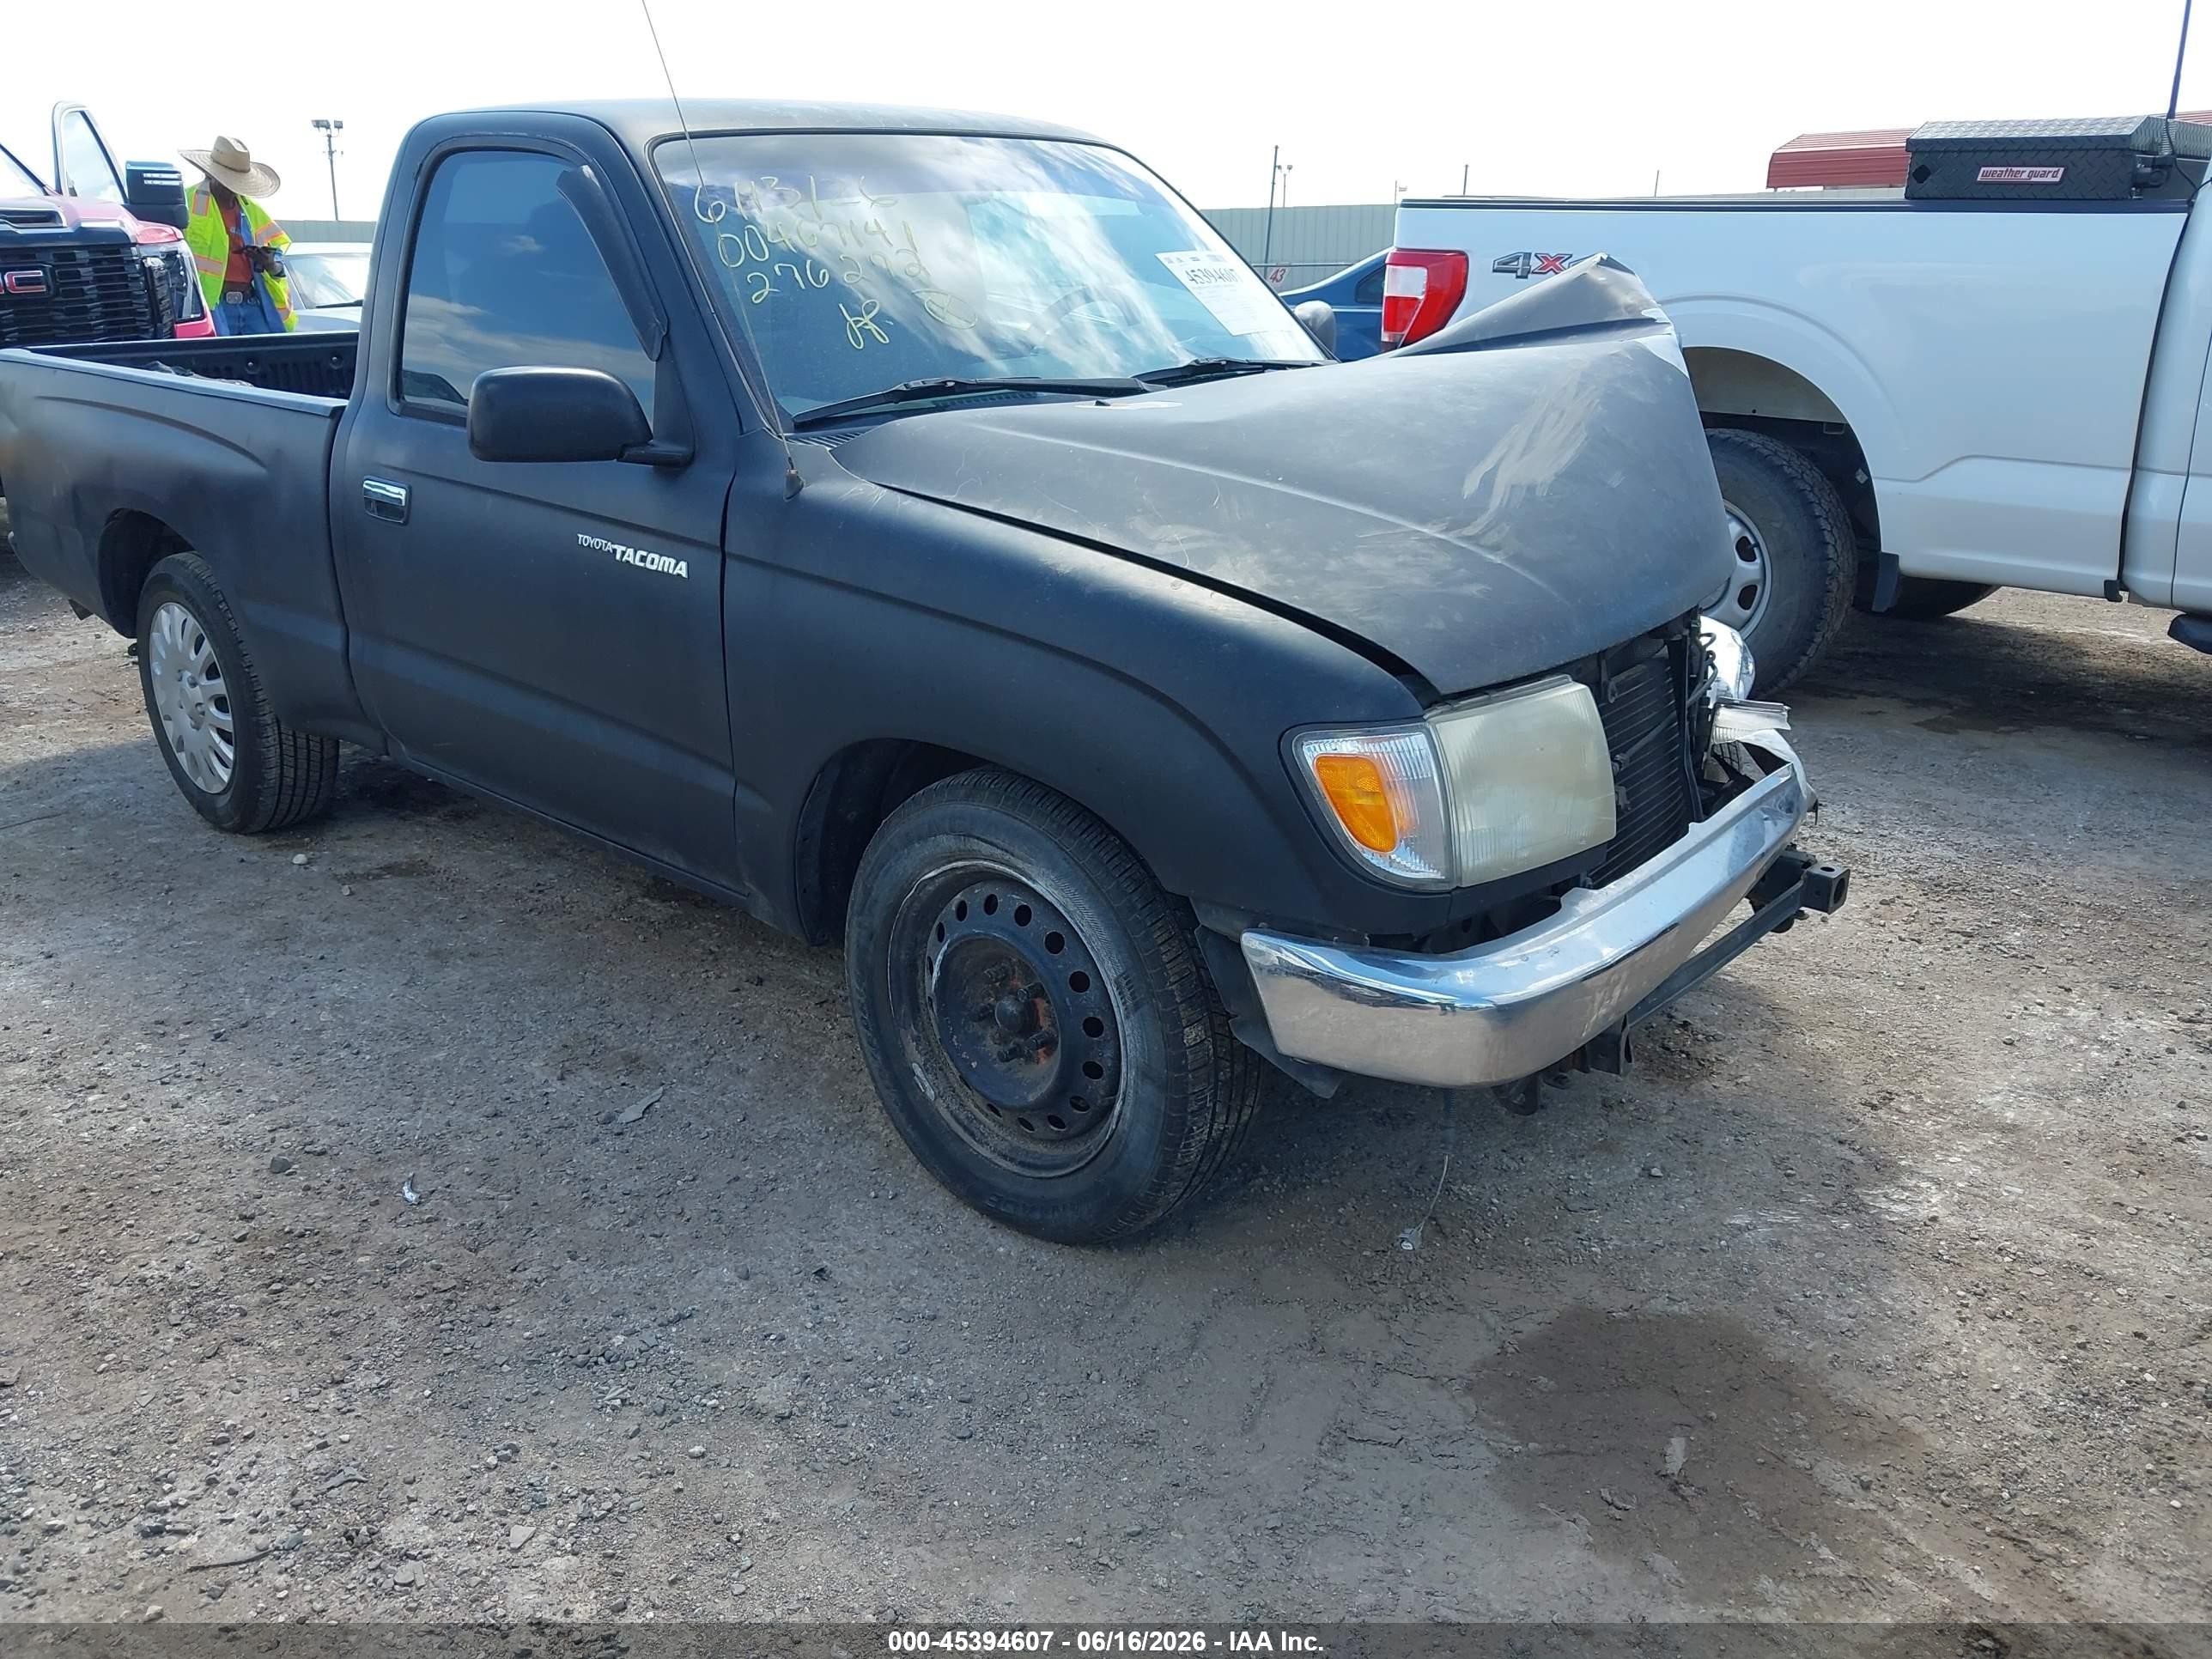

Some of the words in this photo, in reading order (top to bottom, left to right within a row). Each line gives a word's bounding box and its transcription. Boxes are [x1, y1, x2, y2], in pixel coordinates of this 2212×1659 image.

[1981, 167, 2027, 179] weather
[2027, 167, 2061, 180] guard
[1269, 267, 1286, 283] 43
[577, 533, 613, 554] TOYOTA
[611, 544, 689, 579] TACOMA
